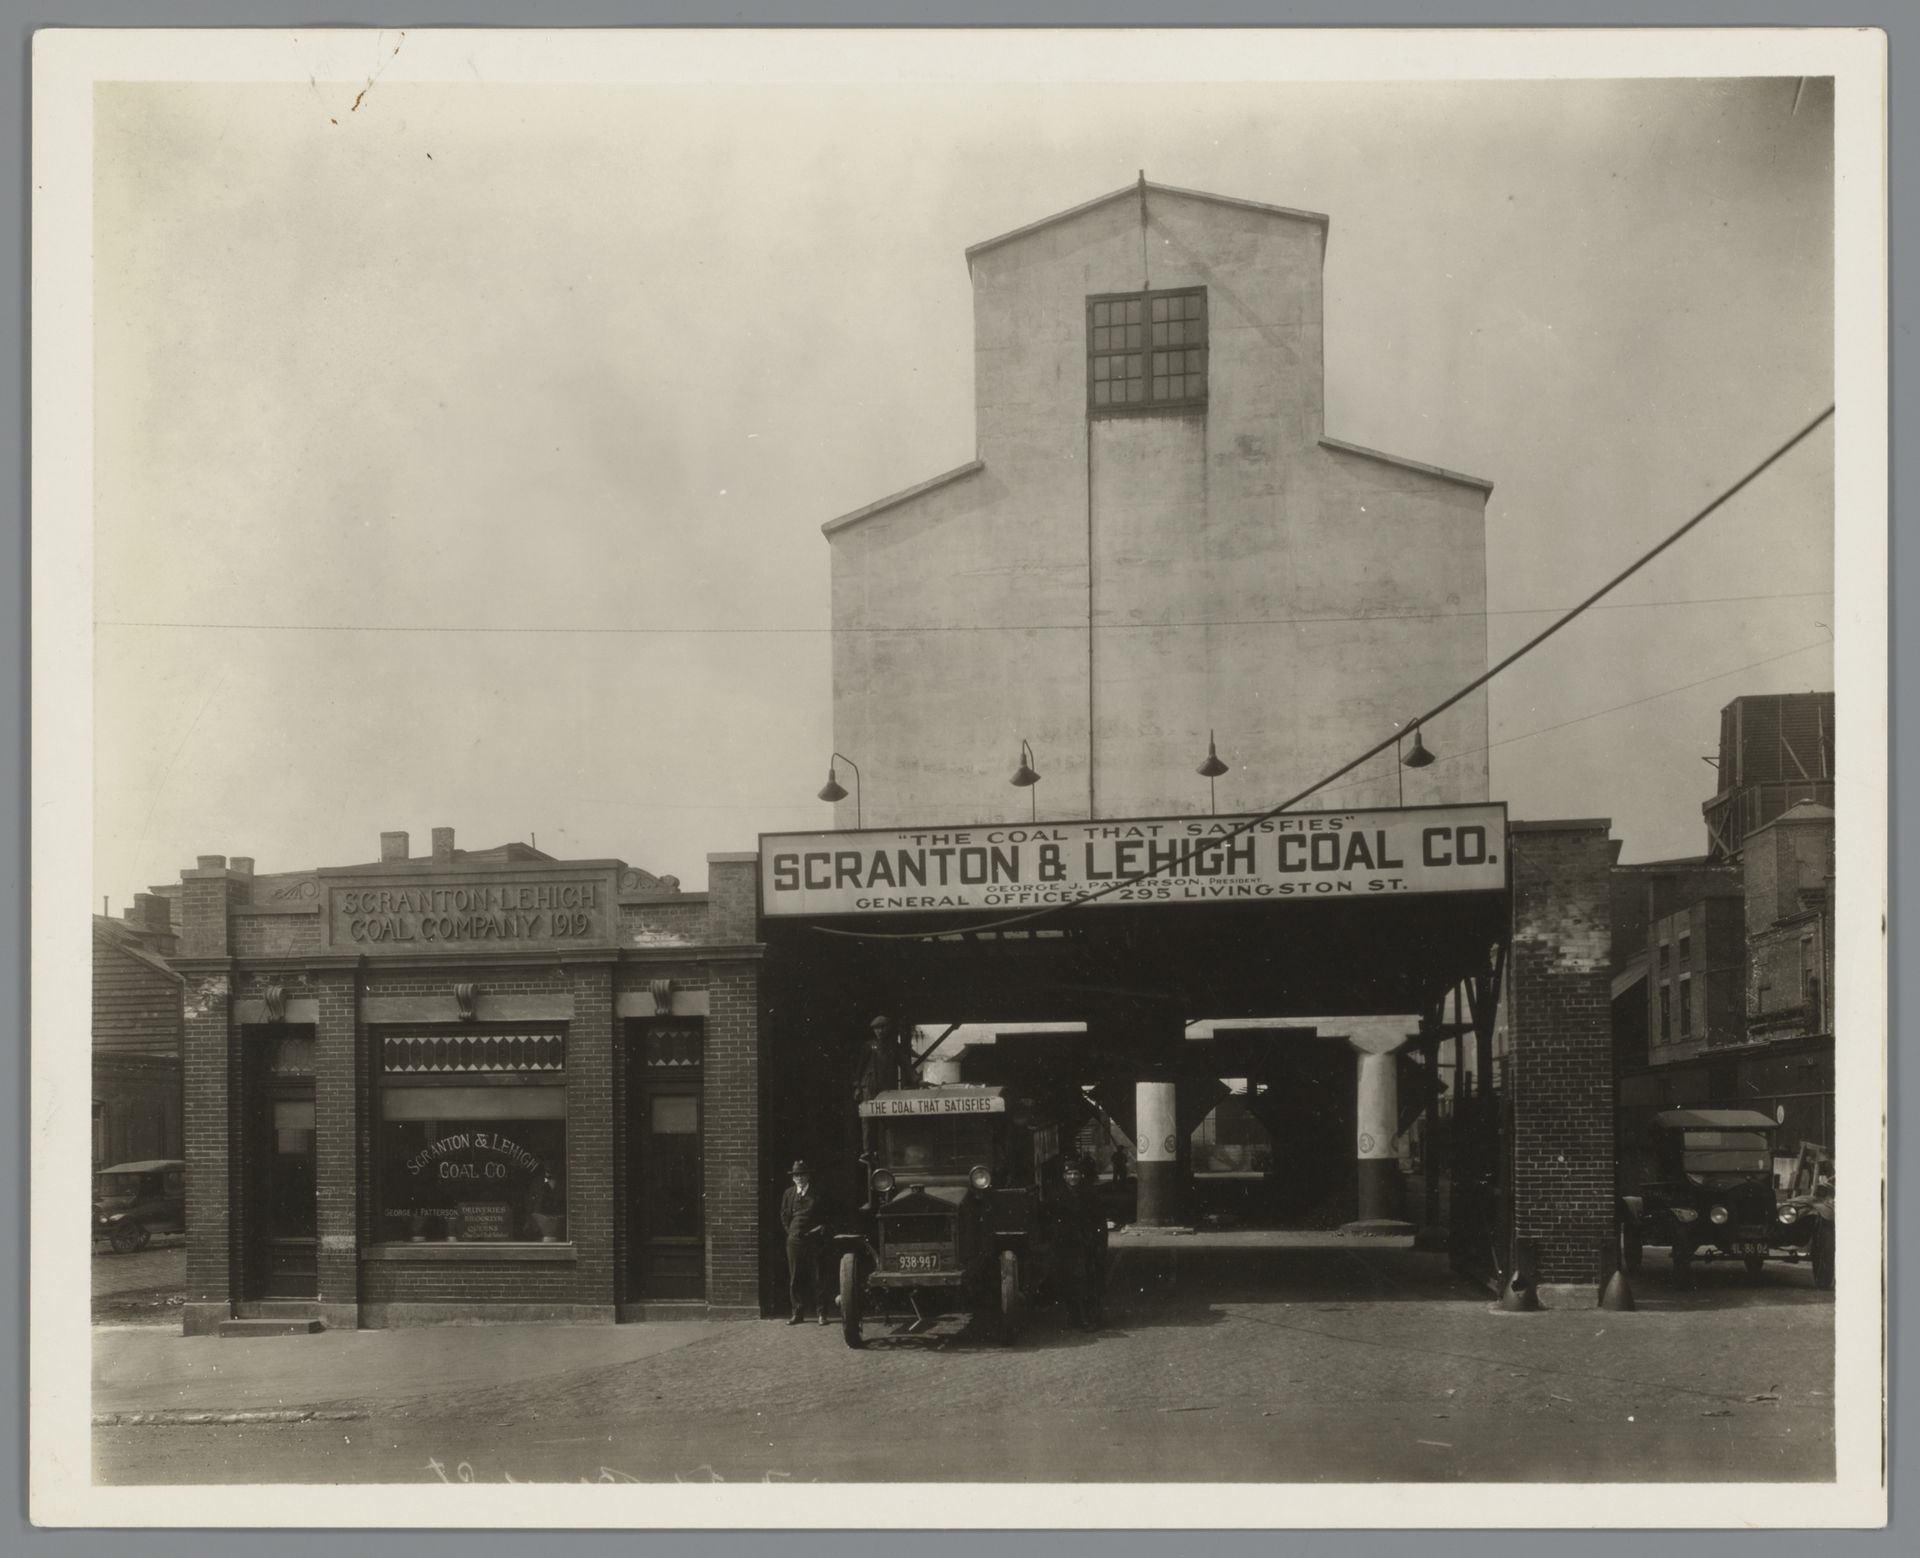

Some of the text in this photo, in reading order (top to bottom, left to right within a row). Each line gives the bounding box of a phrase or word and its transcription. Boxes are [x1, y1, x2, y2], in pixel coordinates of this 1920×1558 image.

[986, 829, 1068, 844] COAL
[1083, 824, 1164, 840] THAT
[773, 825, 1497, 891] SCRANTON & LEHIGH COAL CO.
[855, 895, 970, 909] GENERAL
[1119, 888, 1171, 900] 295
[1184, 880, 1352, 898] LIVINGSTON
[1368, 878, 1407, 891] ST.
[986, 883, 1060, 892] GEORGE
[350, 912, 589, 942] COAL COMPANY 1919
[869, 1101, 887, 1114] THE
[891, 1100, 915, 1114] COAL
[918, 1100, 940, 1113] THAT
[406, 1133, 539, 1175] SCRANTON & LEHIGH
[439, 1161, 479, 1179] COAL
[420, 1207, 459, 1217] PATTERSON
